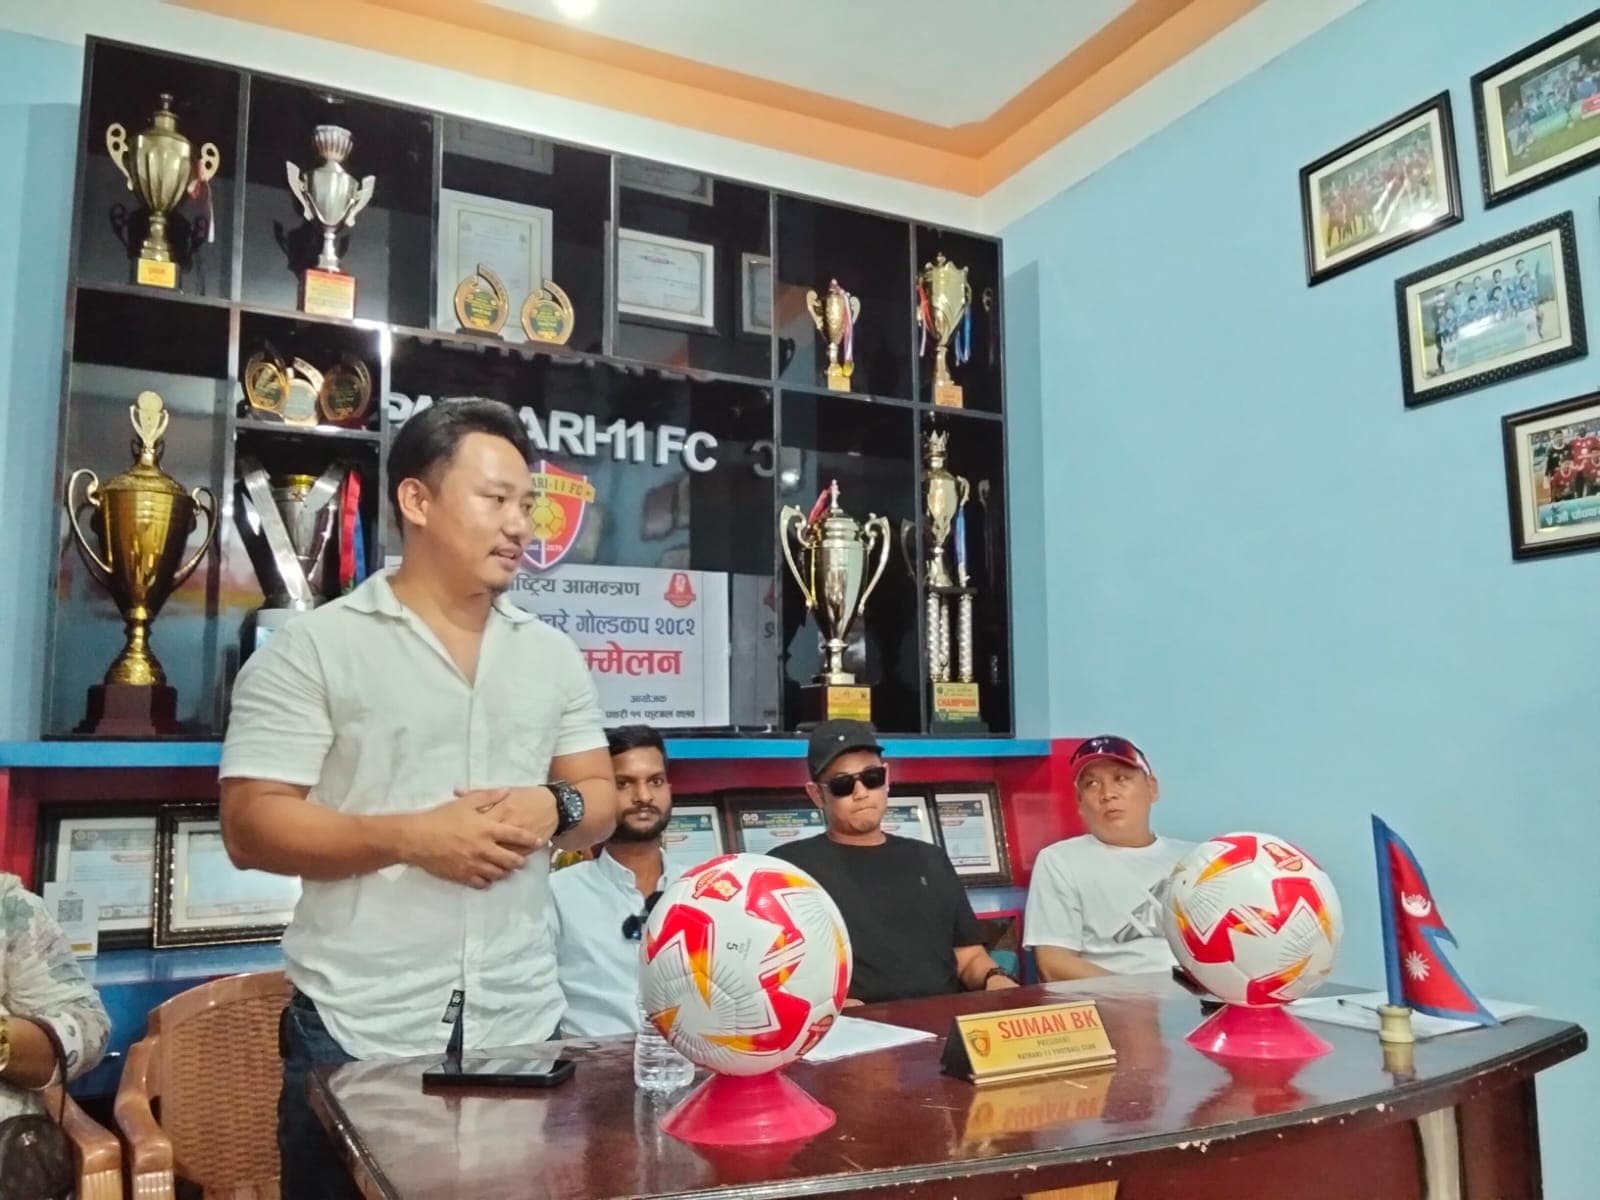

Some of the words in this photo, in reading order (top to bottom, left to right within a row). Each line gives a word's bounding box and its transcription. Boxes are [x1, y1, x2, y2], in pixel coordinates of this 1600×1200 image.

[388, 392, 646, 462] PARI-11
[657, 424, 718, 473] FC
[562, 579, 640, 597] आमन्त्रण
[576, 609, 649, 635] गोल्डकप
[656, 617, 696, 636] २०८२
[580, 640, 683, 677] म्मेलन
[726, 942, 738, 951] 5
[997, 1013, 1067, 1039] SUMAN
[1070, 1010, 1098, 1030] BK
